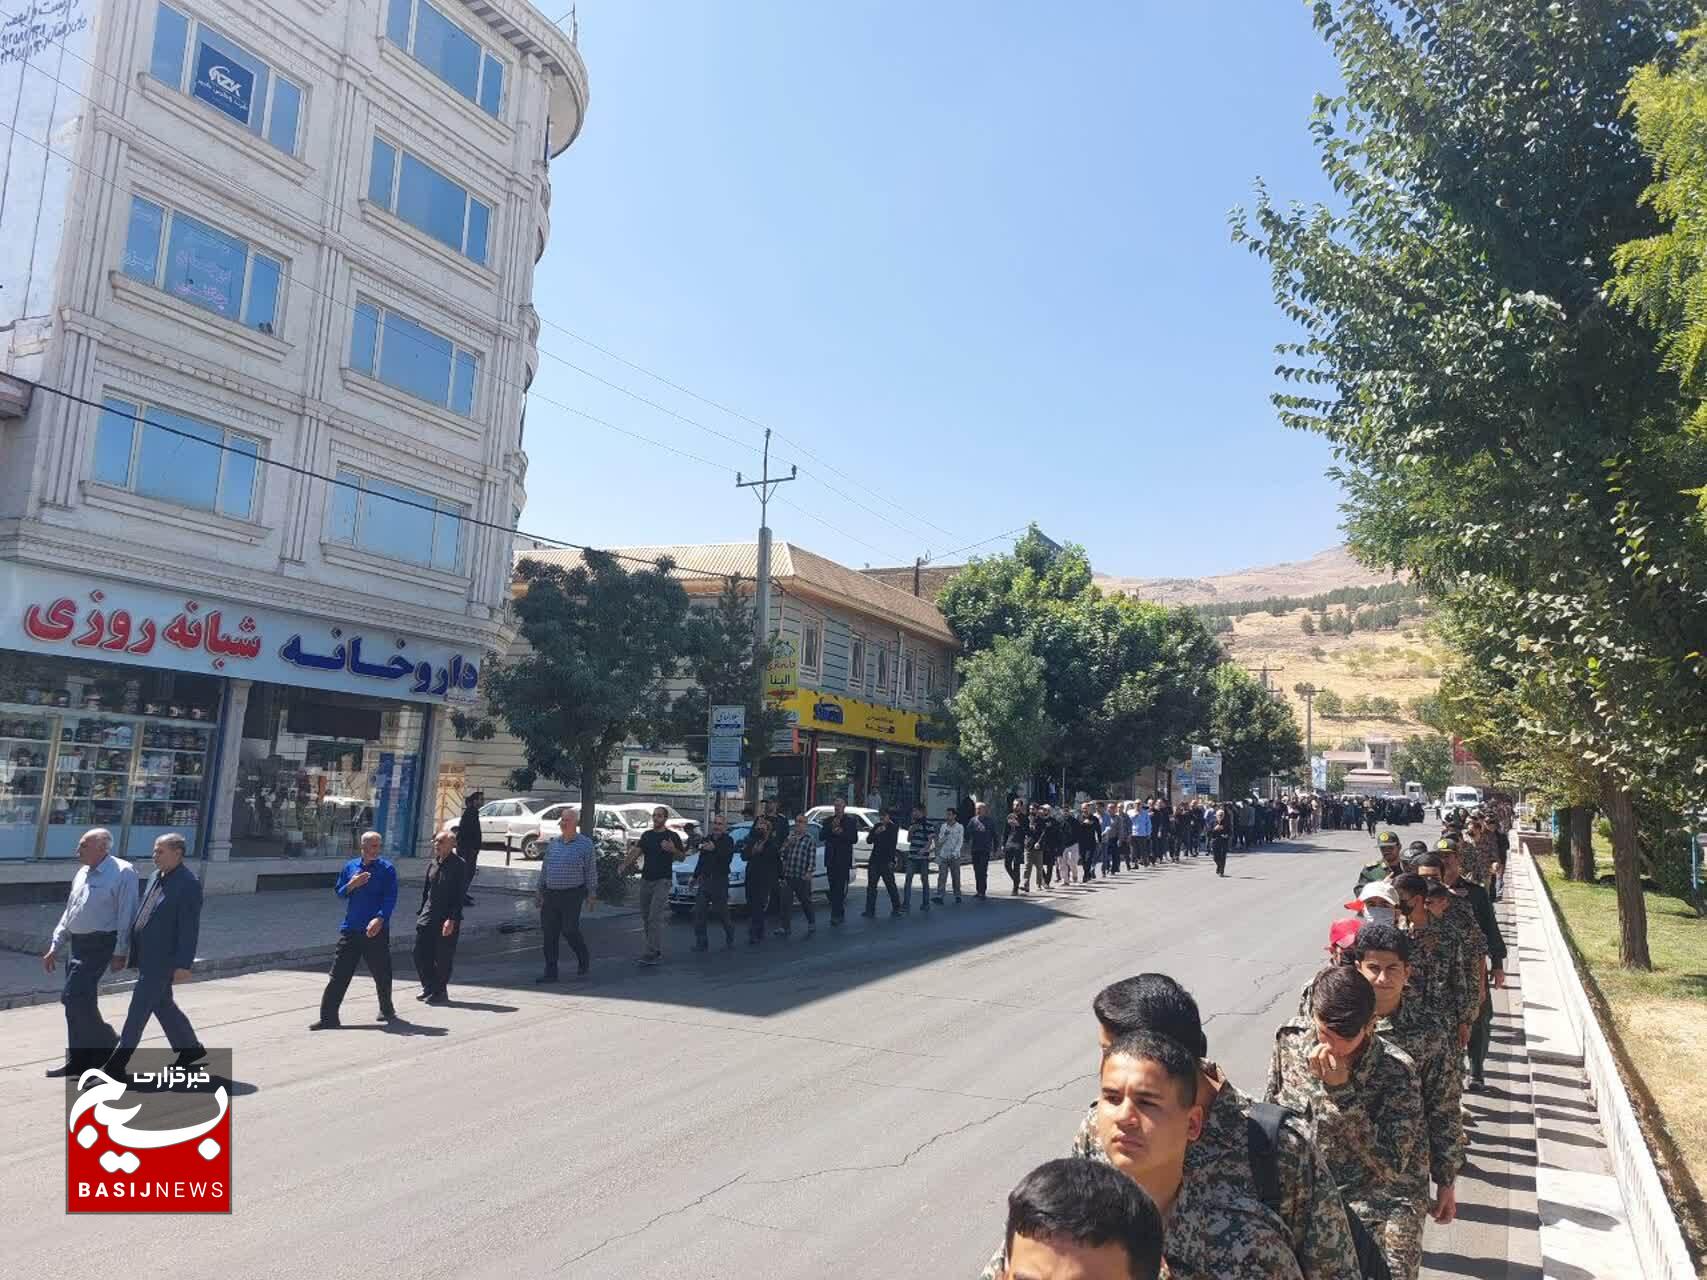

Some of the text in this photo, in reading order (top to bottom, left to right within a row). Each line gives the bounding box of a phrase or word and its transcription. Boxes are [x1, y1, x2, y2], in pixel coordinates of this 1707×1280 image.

[24, 590, 480, 697] داروخانه شبانه روزی
